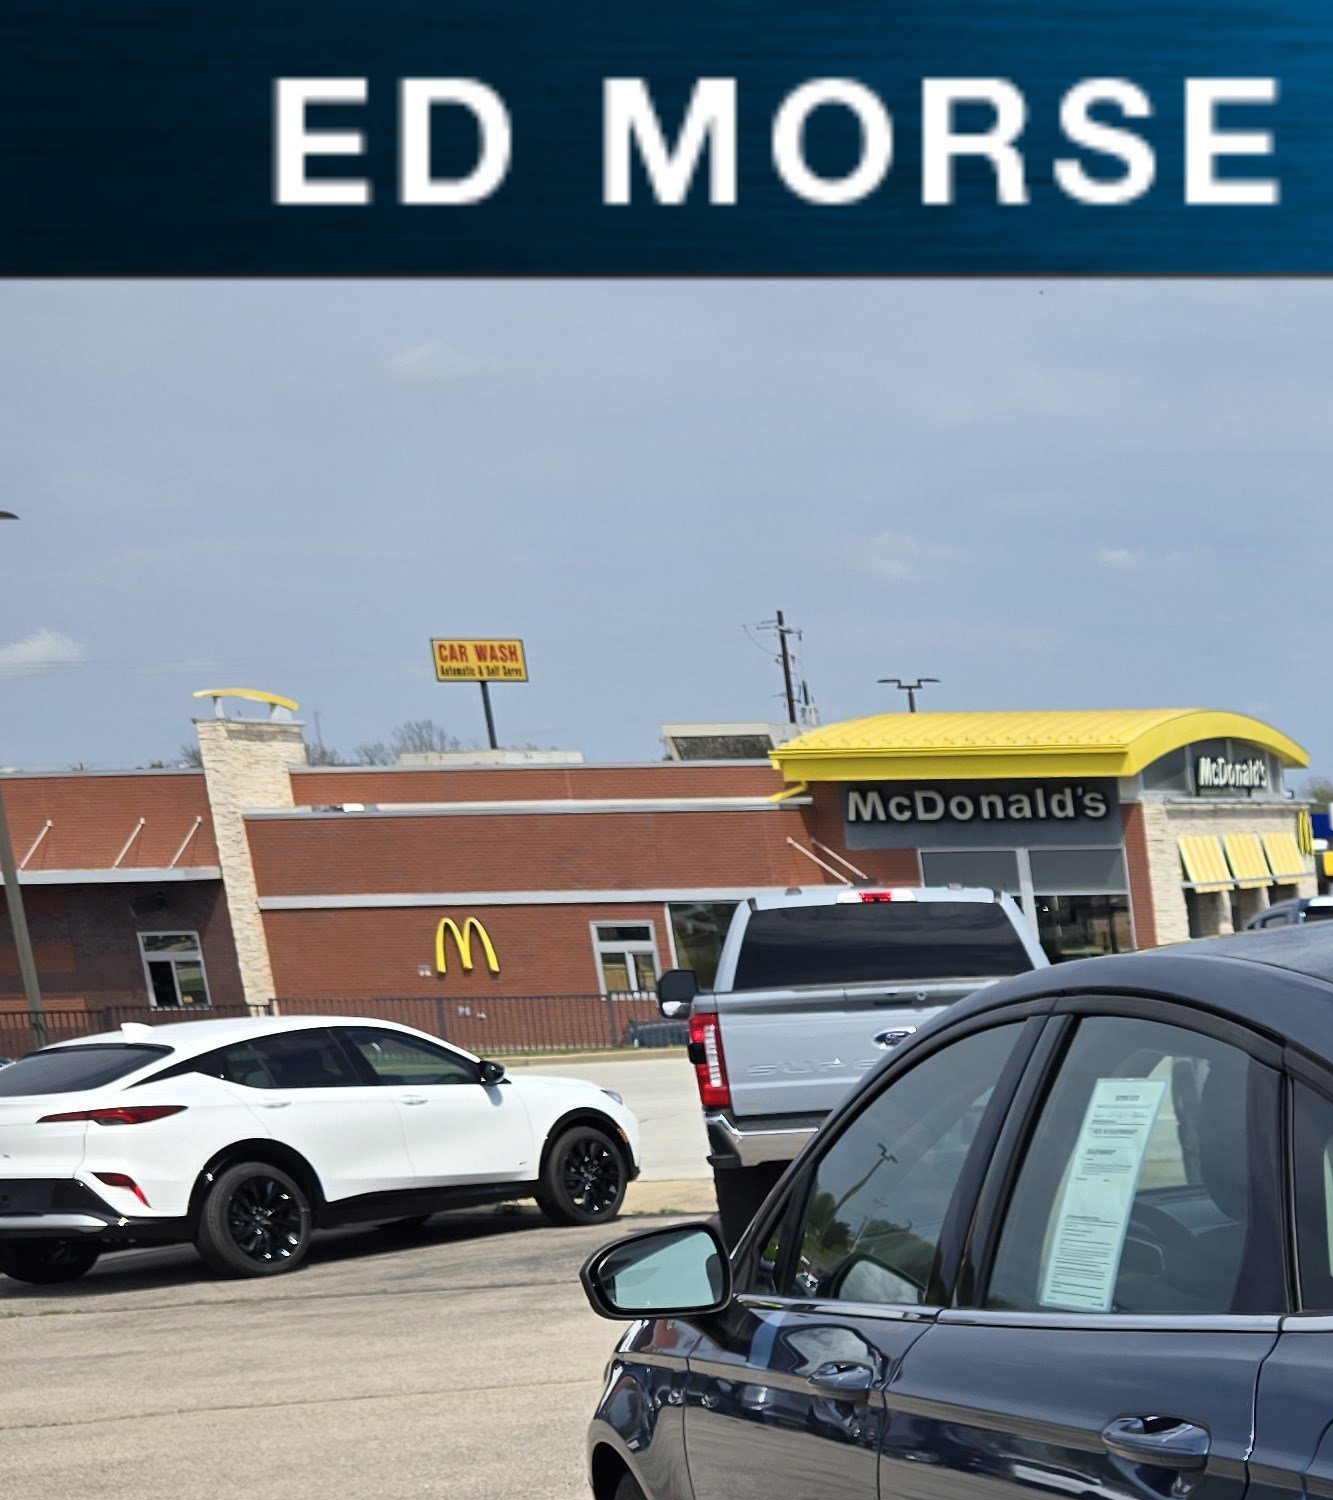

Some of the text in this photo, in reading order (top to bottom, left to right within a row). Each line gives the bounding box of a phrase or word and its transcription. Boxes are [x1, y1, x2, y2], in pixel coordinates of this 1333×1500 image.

[438, 644, 519, 663] CAR WASH
[1199, 757, 1268, 788] McDonald's
[847, 785, 1108, 822] McDonald's
